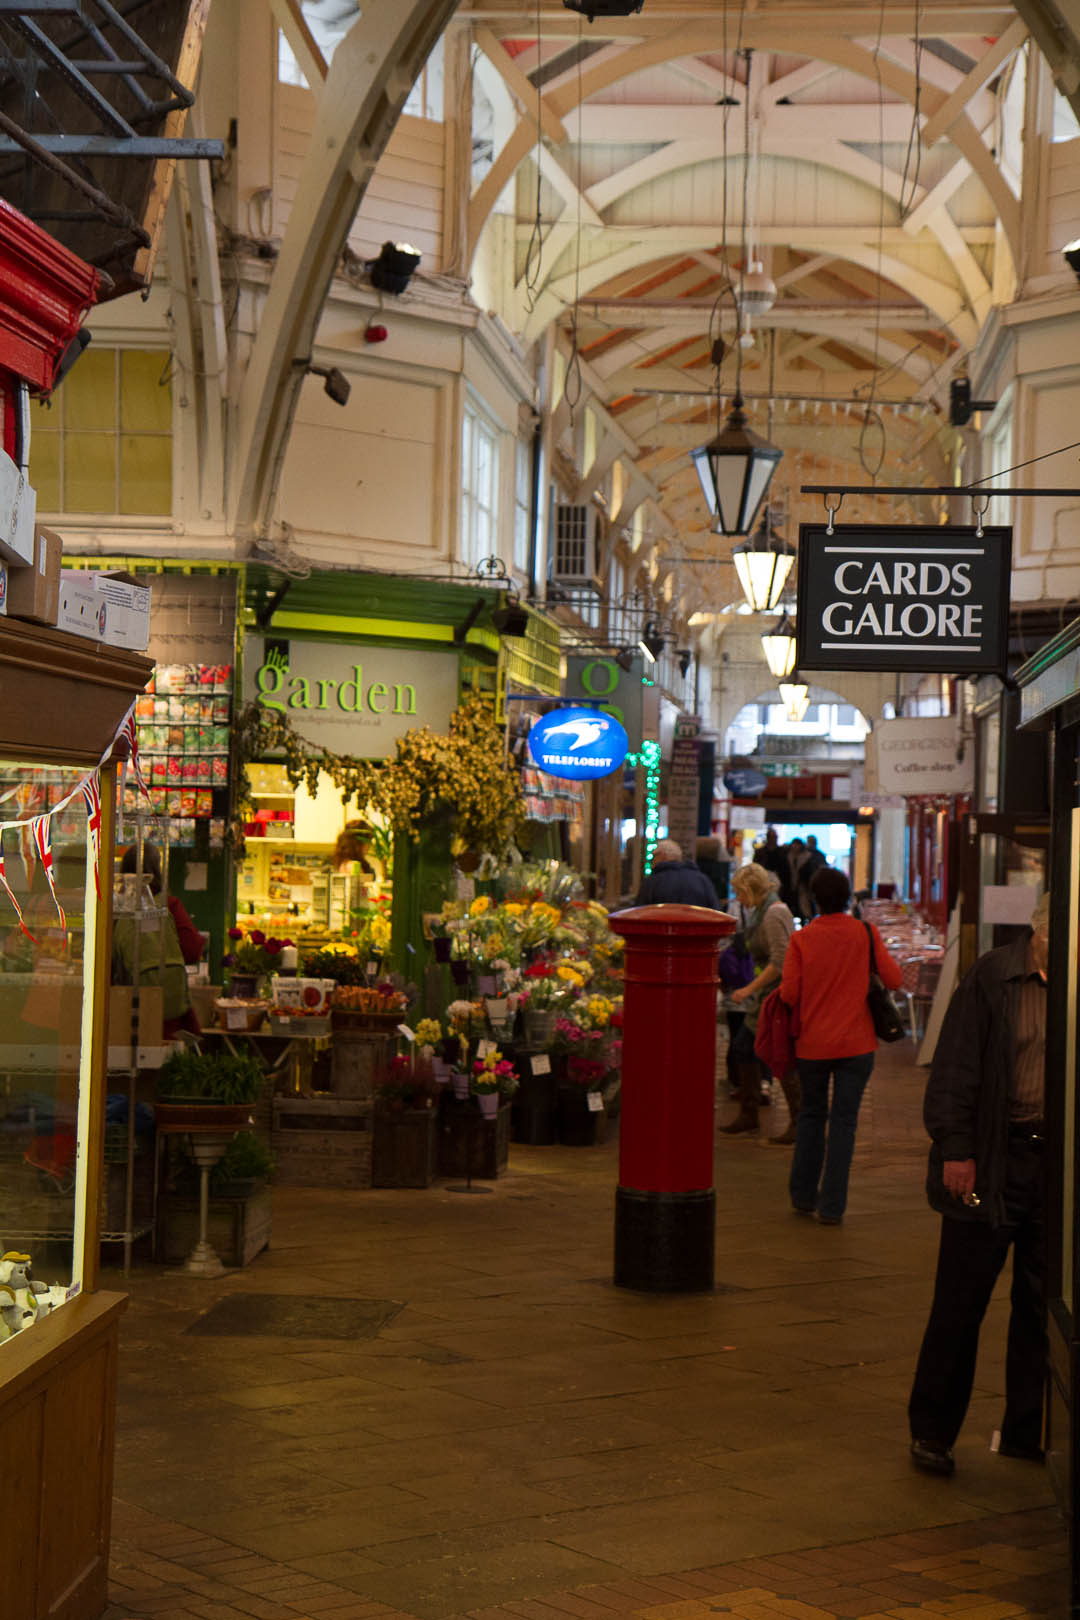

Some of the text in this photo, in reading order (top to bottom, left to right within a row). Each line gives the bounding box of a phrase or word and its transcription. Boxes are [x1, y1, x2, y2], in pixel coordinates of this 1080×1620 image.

[833, 560, 972, 597] CARDS
[821, 602, 983, 638] GALORE
[267, 645, 288, 666] the
[256, 664, 418, 727] garden
[542, 755, 612, 768] TELEFLORIST
